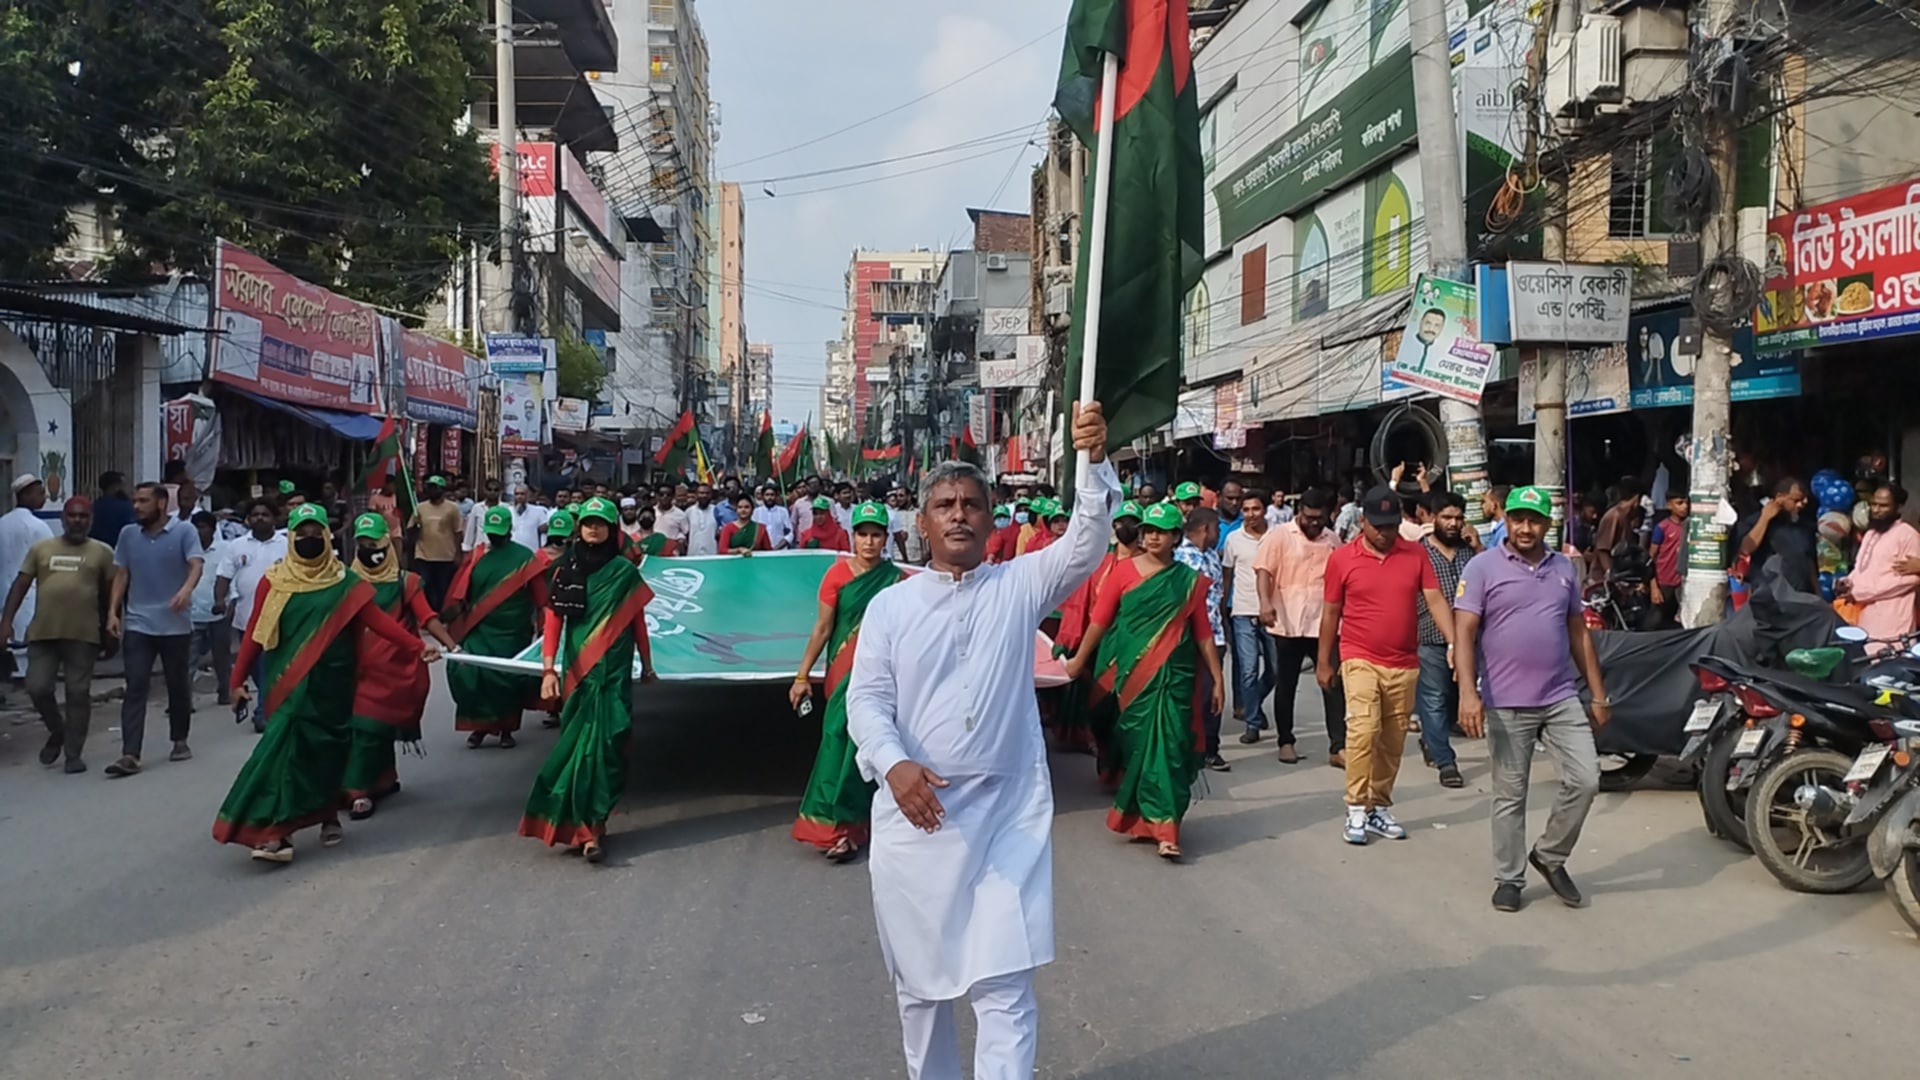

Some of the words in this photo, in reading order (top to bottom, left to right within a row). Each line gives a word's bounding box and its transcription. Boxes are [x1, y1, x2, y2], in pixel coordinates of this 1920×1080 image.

[1792, 213, 1836, 277] নিউ
[1516, 268, 1575, 295] ওয়েসিস
[1579, 269, 1629, 297] বেকারী
[1537, 301, 1562, 317] এন্ড
[991, 311, 1021, 330] STEP
[987, 366, 1016, 381] Apex
